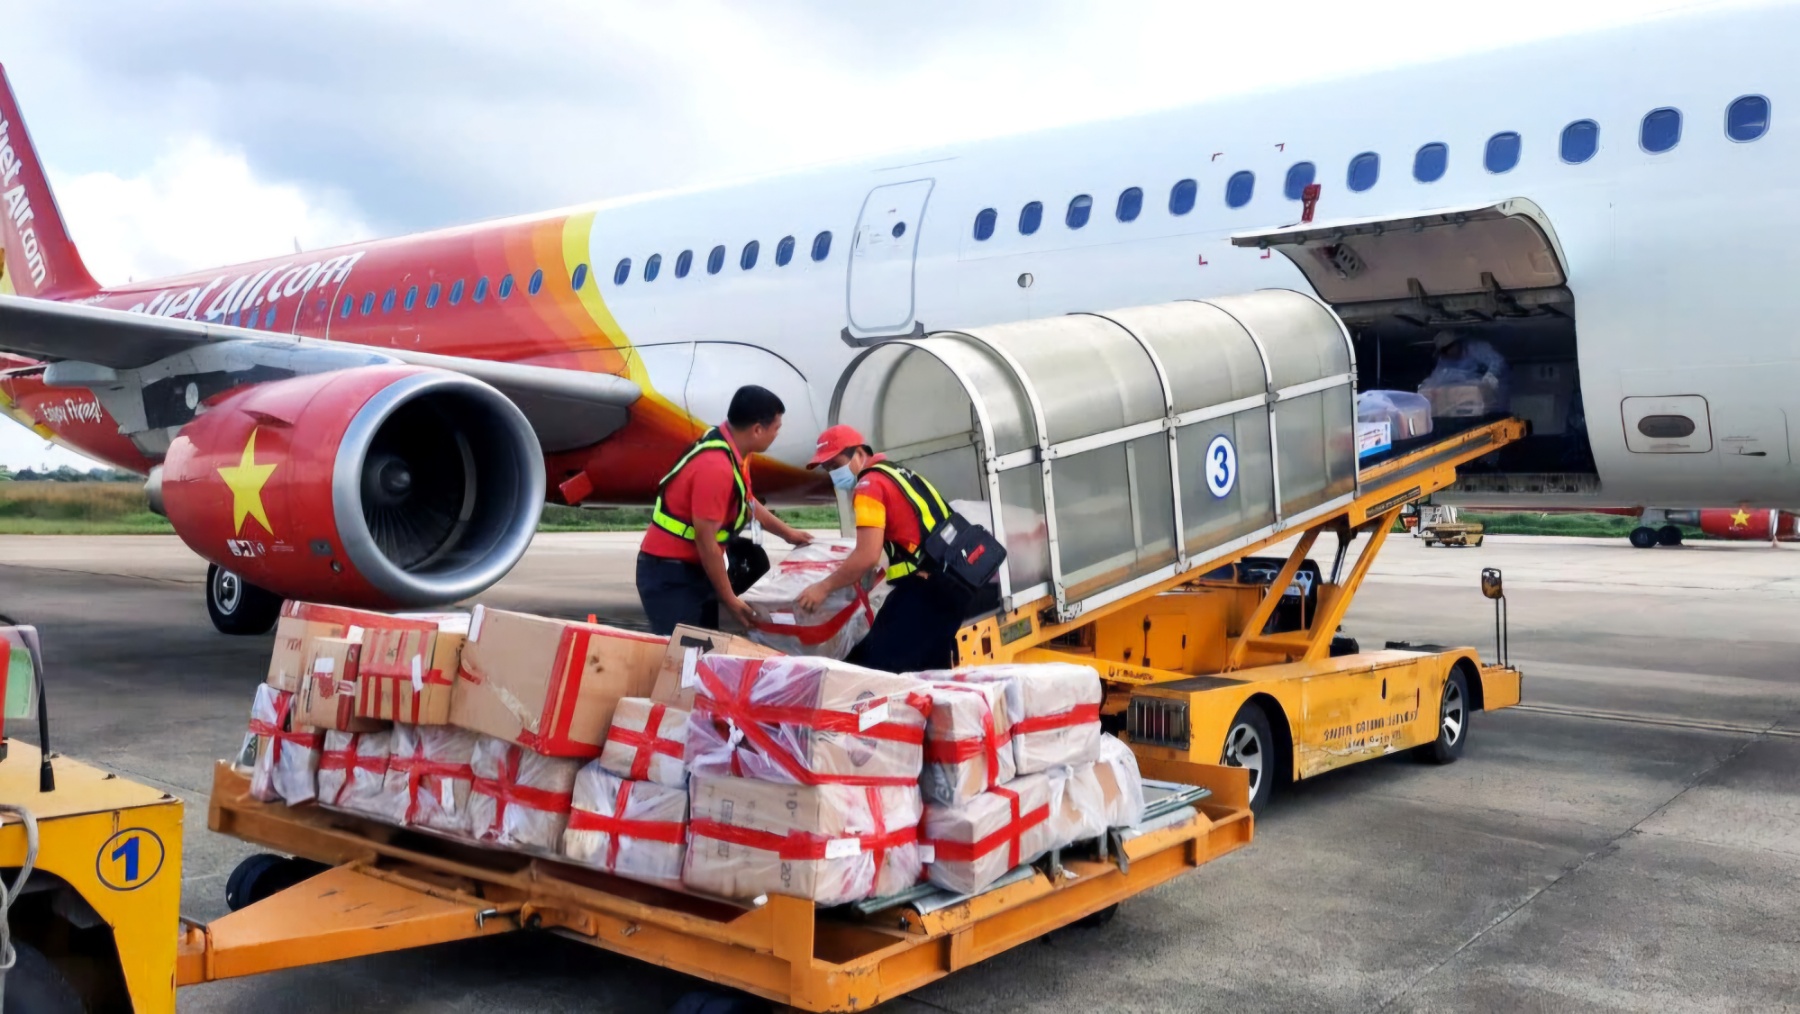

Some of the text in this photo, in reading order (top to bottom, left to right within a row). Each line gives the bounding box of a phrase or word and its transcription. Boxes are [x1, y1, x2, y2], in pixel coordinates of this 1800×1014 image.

[4, 184, 46, 289] Air.com
[203, 251, 366, 321] Air.com
[1214, 445, 1229, 488] 3
[112, 836, 139, 882] 1
